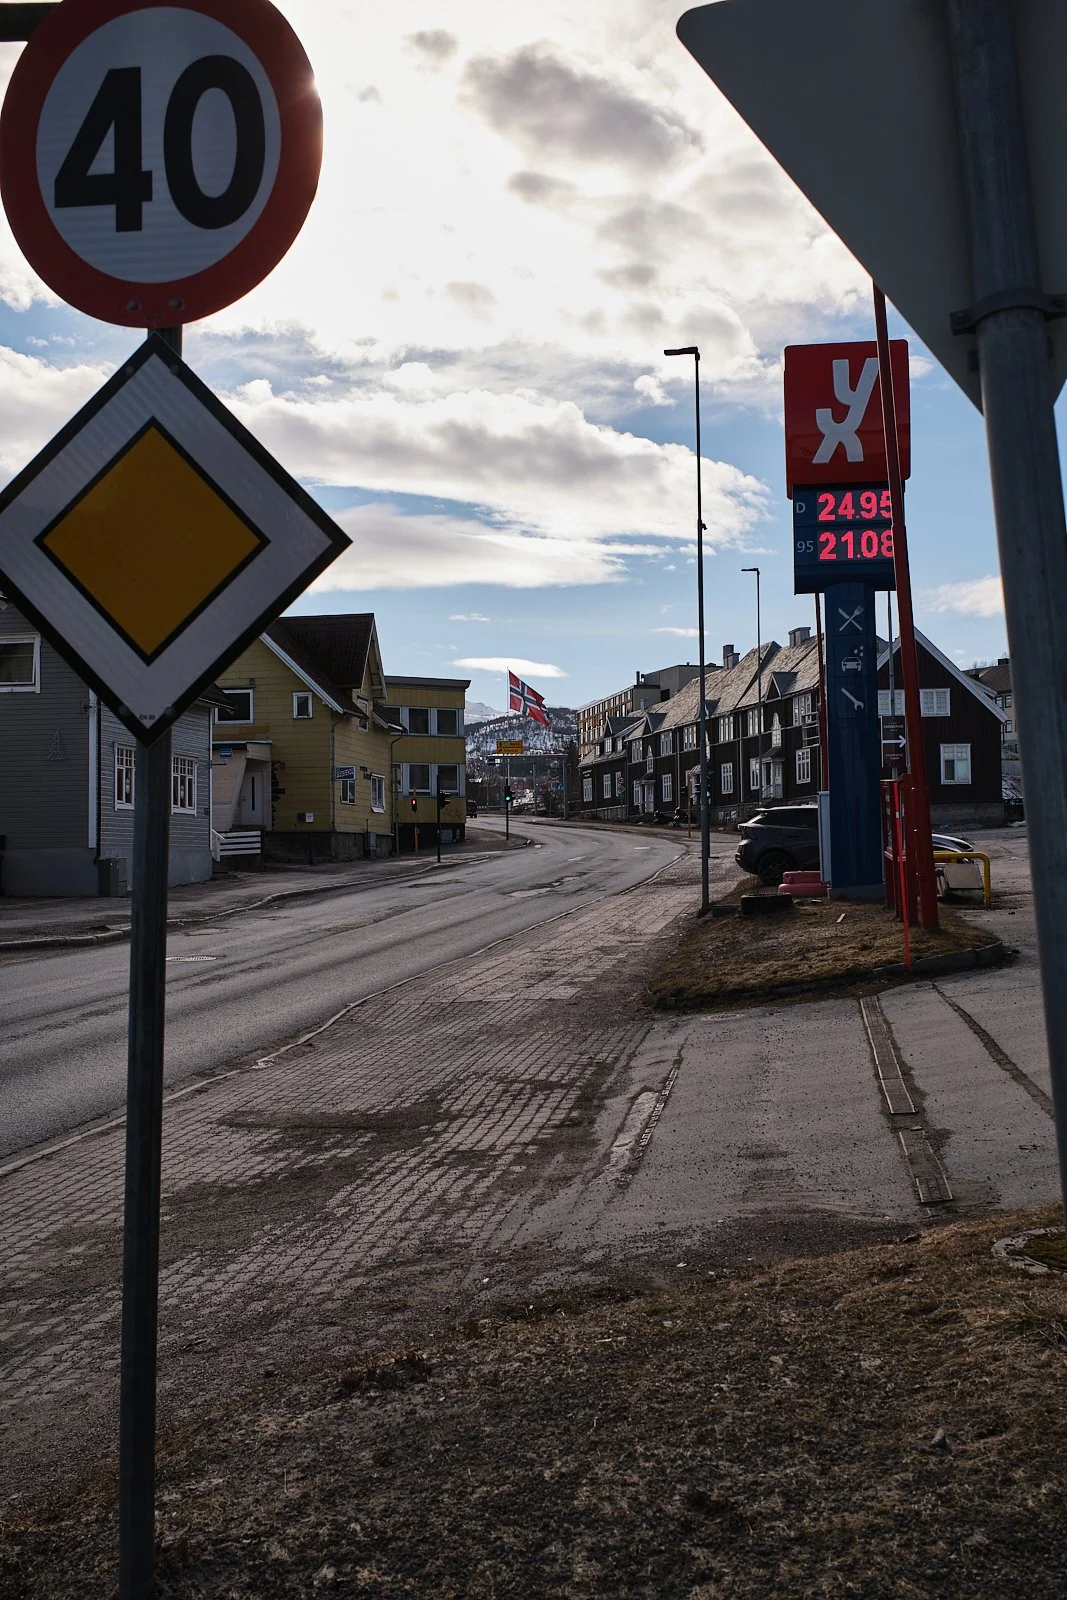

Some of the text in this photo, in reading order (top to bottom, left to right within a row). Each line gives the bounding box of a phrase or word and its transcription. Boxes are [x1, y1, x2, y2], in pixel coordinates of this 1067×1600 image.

[54, 54, 266, 233] 40
[796, 490, 893, 521] D 24.95
[797, 529, 895, 560] 95 21.08
